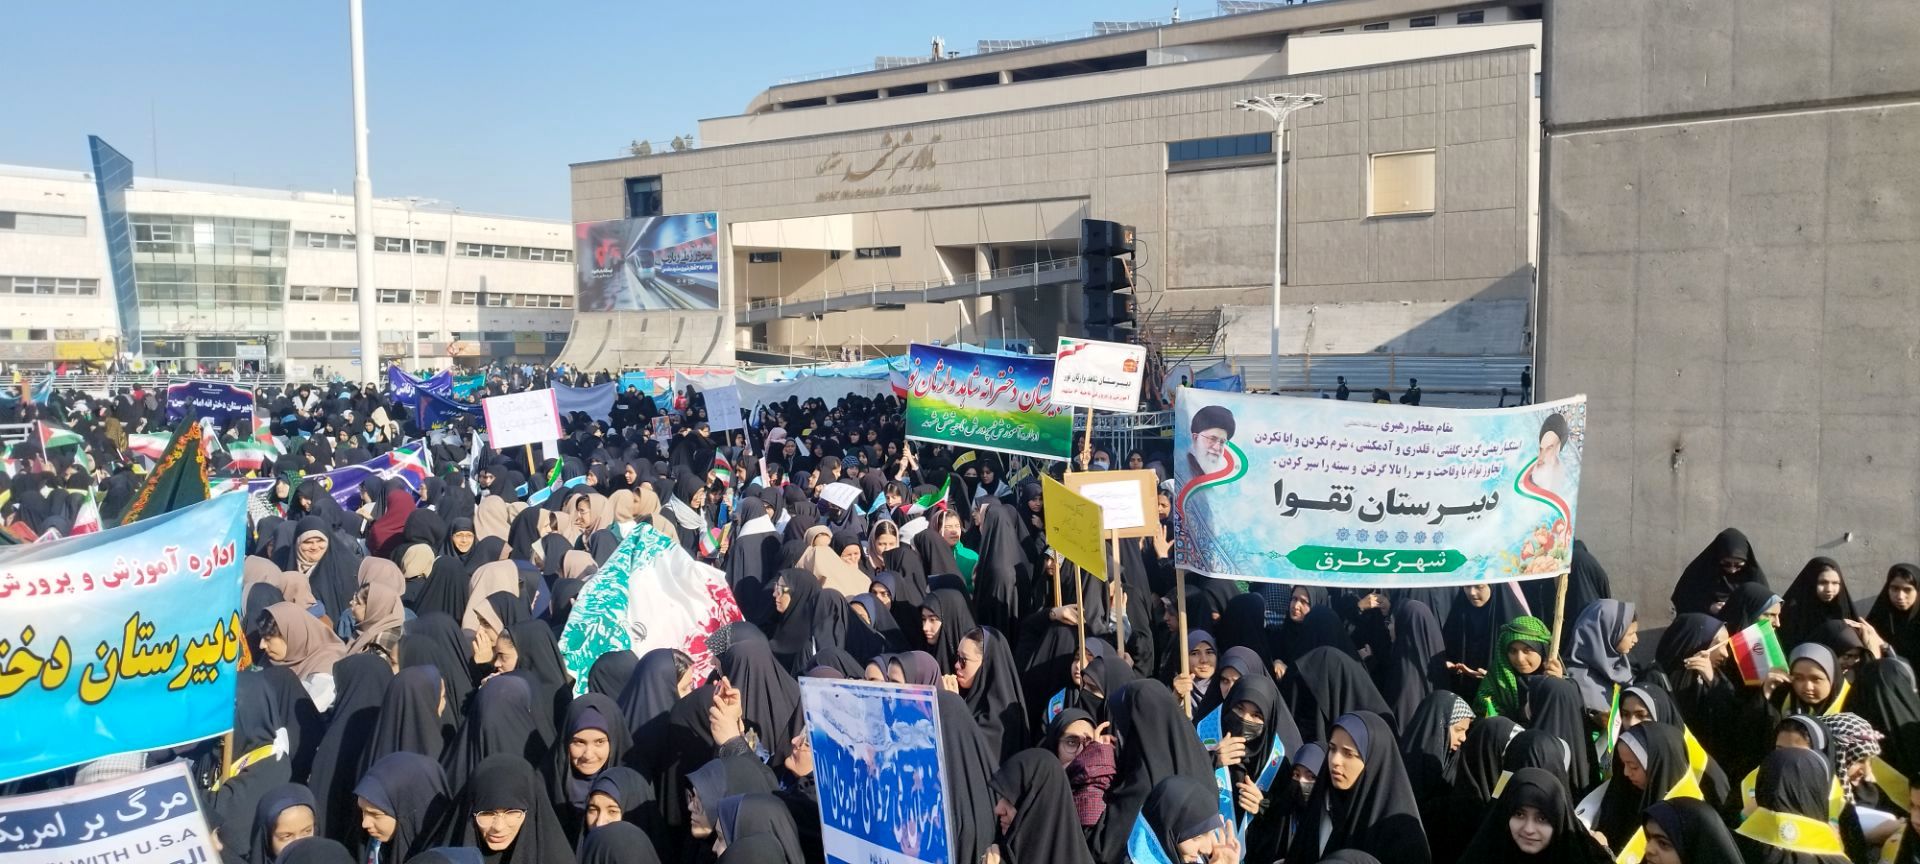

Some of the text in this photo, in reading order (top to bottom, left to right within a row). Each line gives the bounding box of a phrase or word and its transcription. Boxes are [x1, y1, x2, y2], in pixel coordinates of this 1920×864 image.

[914, 358, 957, 398] وارثان
[956, 364, 981, 408] شاهد
[980, 366, 1018, 406] دخترانه
[1381, 421, 1409, 434] رهبری
[1411, 421, 1434, 433] معظم
[1436, 422, 1454, 436] مقام
[1254, 431, 1282, 445] نکردن
[1294, 438, 1300, 447] و
[1301, 435, 1329, 449] نکردن
[1330, 438, 1348, 450] شرم
[1356, 440, 1394, 453] آدمکشی
[1395, 446, 1401, 456] و
[1402, 444, 1431, 457] قلدری
[1321, 459, 1329, 473] را
[1331, 460, 1350, 473] سینه
[1352, 465, 1357, 475] و
[1361, 461, 1387, 476] گرفتن
[1389, 463, 1401, 477] بالا
[1404, 465, 1412, 478] را
[1413, 467, 1425, 479] سر
[1434, 465, 1460, 479] وقاحت
[1461, 465, 1467, 478] با
[1426, 469, 1431, 479] و
[1273, 478, 1500, 525] دبیرستان تقوا
[1315, 550, 1447, 573] شهرک طرق
[0, 542, 235, 599] اداره آموزش و پرورش
[79, 609, 241, 705] دبیرستان
[116, 787, 189, 822] مرگ
[79, 813, 106, 841] بر
[136, 828, 197, 855] U.S.A
